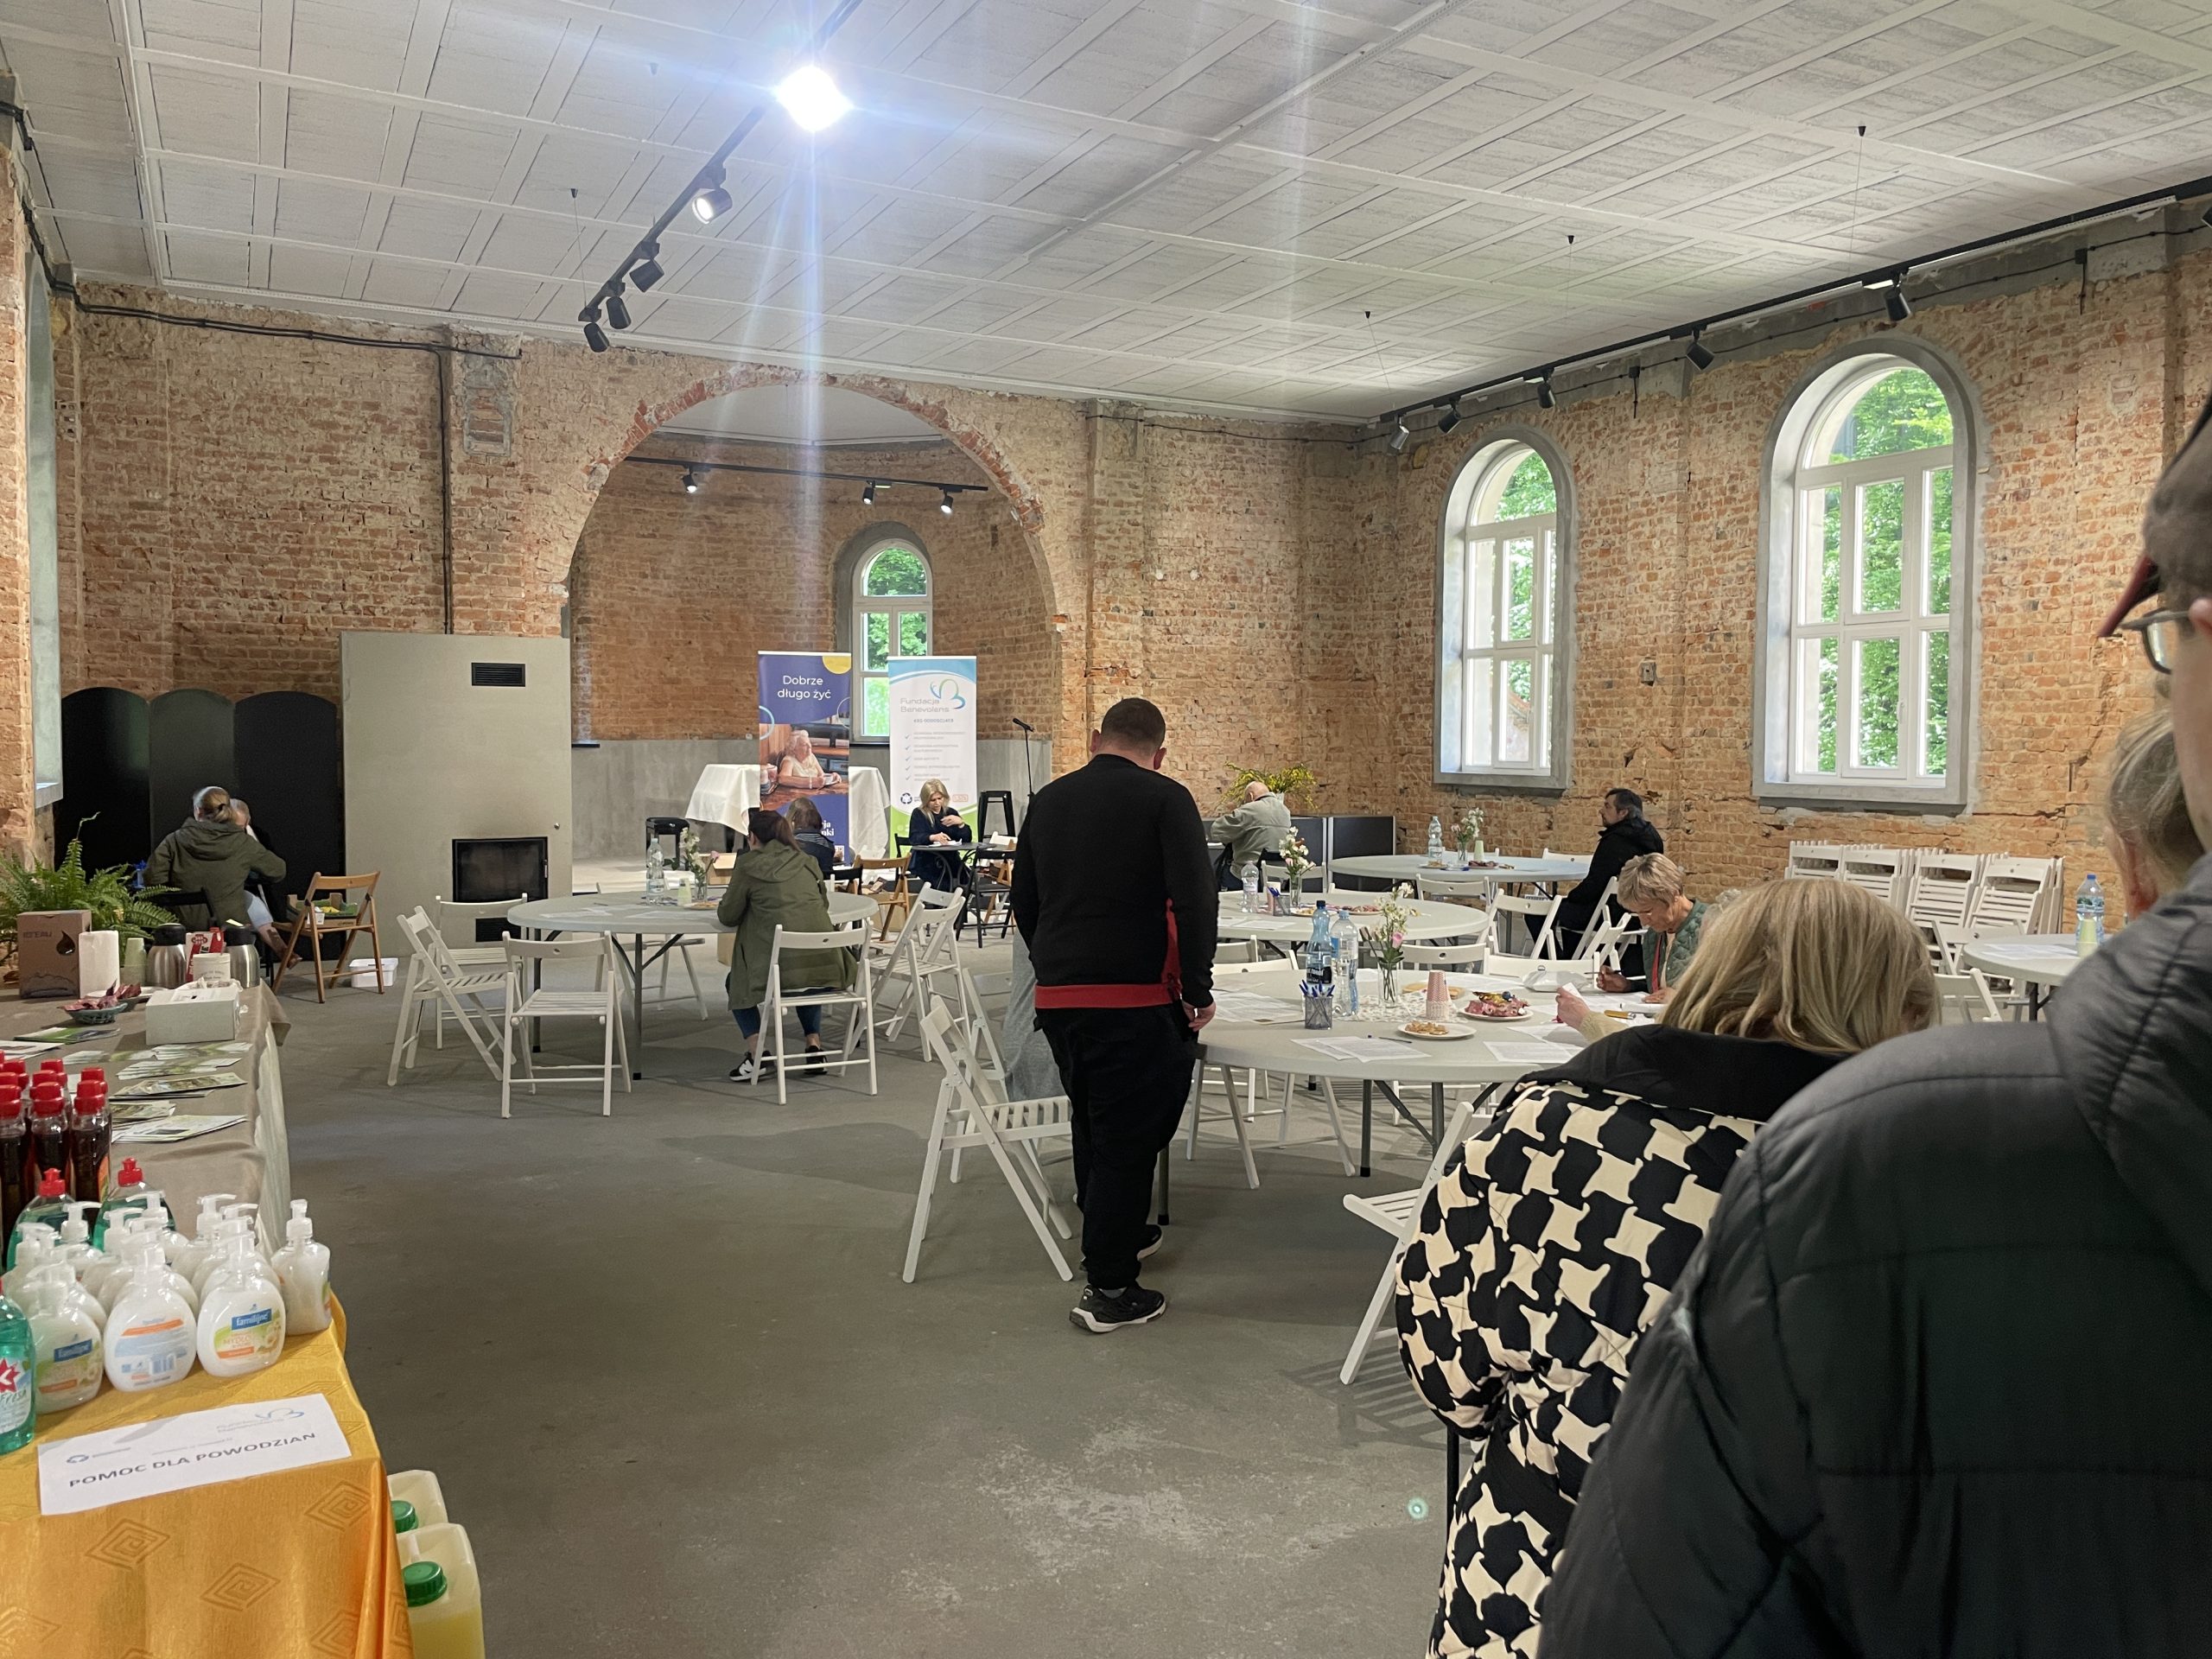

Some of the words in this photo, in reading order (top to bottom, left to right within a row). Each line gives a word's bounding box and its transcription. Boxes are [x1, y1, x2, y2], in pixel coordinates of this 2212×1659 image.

[783, 675, 823, 685] Dobrze
[778, 688, 810, 700] długo
[813, 689, 831, 701] żyć
[69, 1465, 148, 1487] POMOC
[152, 1458, 191, 1469] DLA
[196, 1433, 316, 1461] POWODZIAN
